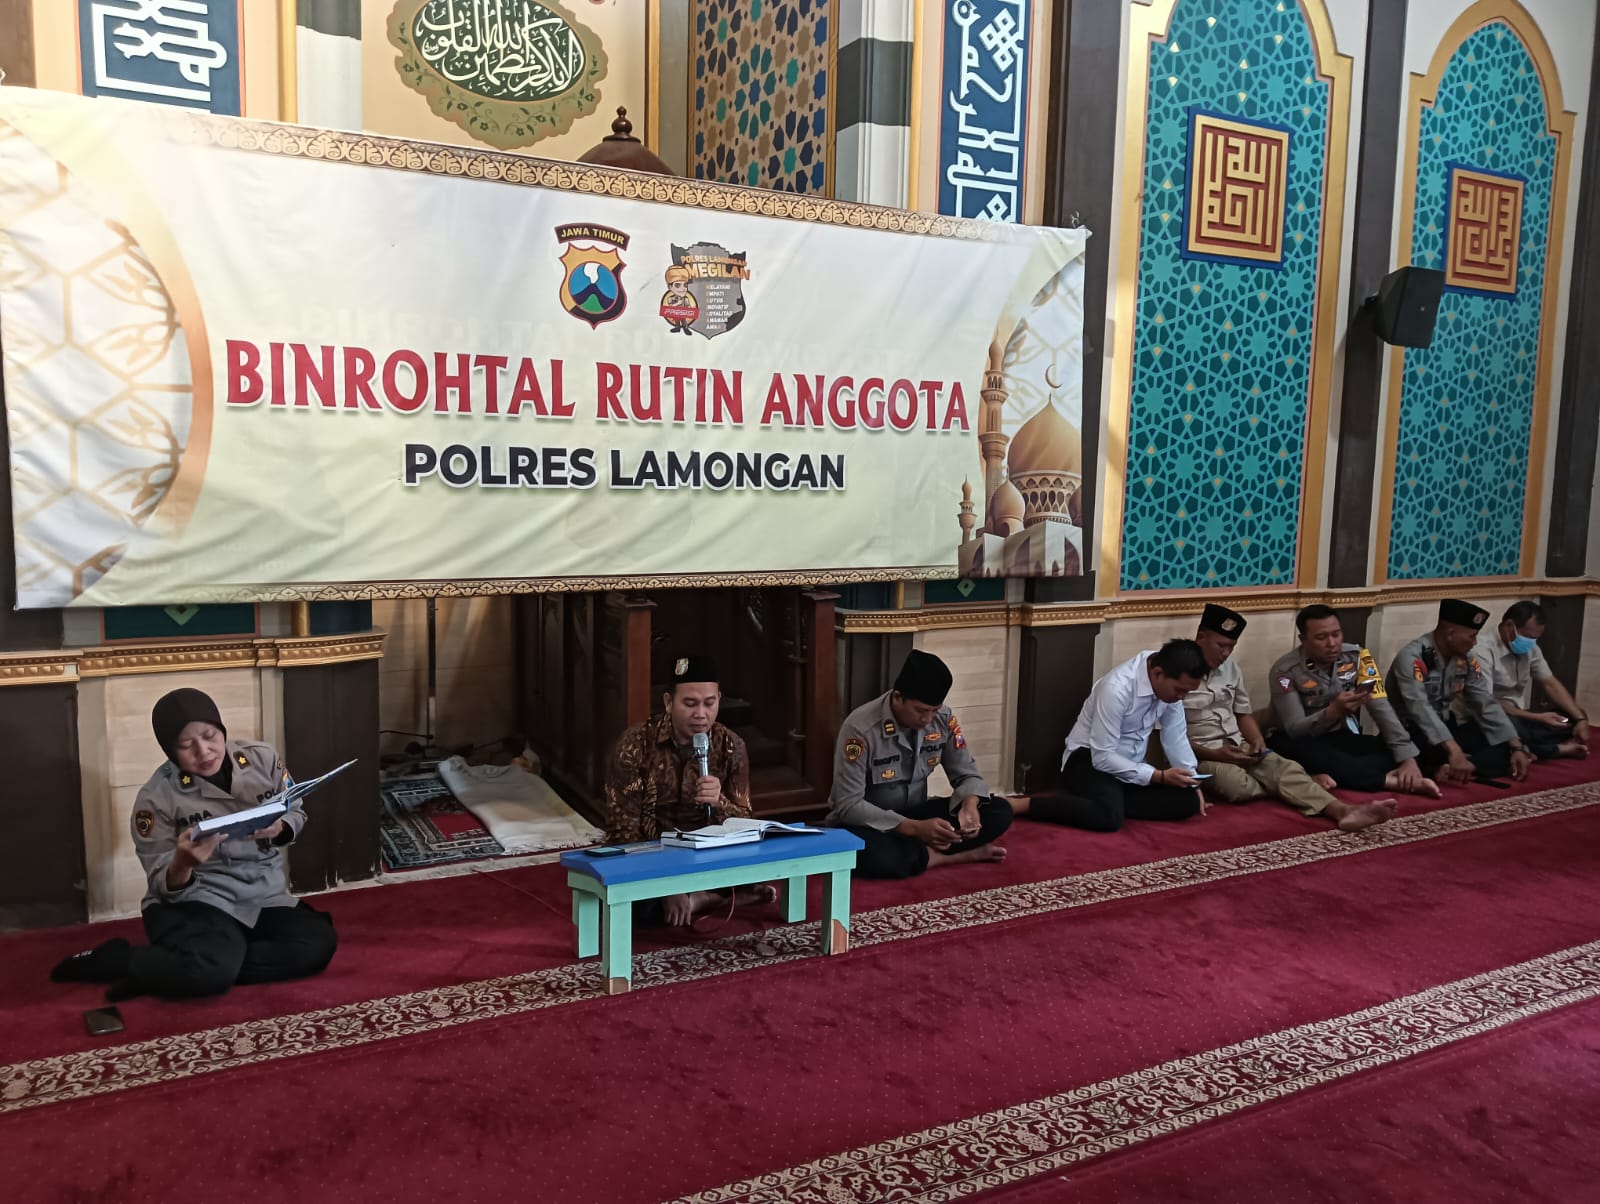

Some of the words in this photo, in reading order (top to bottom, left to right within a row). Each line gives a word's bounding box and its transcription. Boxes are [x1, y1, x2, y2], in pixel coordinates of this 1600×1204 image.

[561, 227, 590, 238] JAWA
[592, 228, 625, 245] TIMUR
[685, 263, 751, 281] MEGILAN
[226, 339, 575, 417] BINROHTAL
[596, 362, 744, 424] RUTIN
[760, 372, 970, 432] ANGGOTA
[405, 443, 596, 487] POLRES
[610, 449, 845, 493] LAMONGAN
